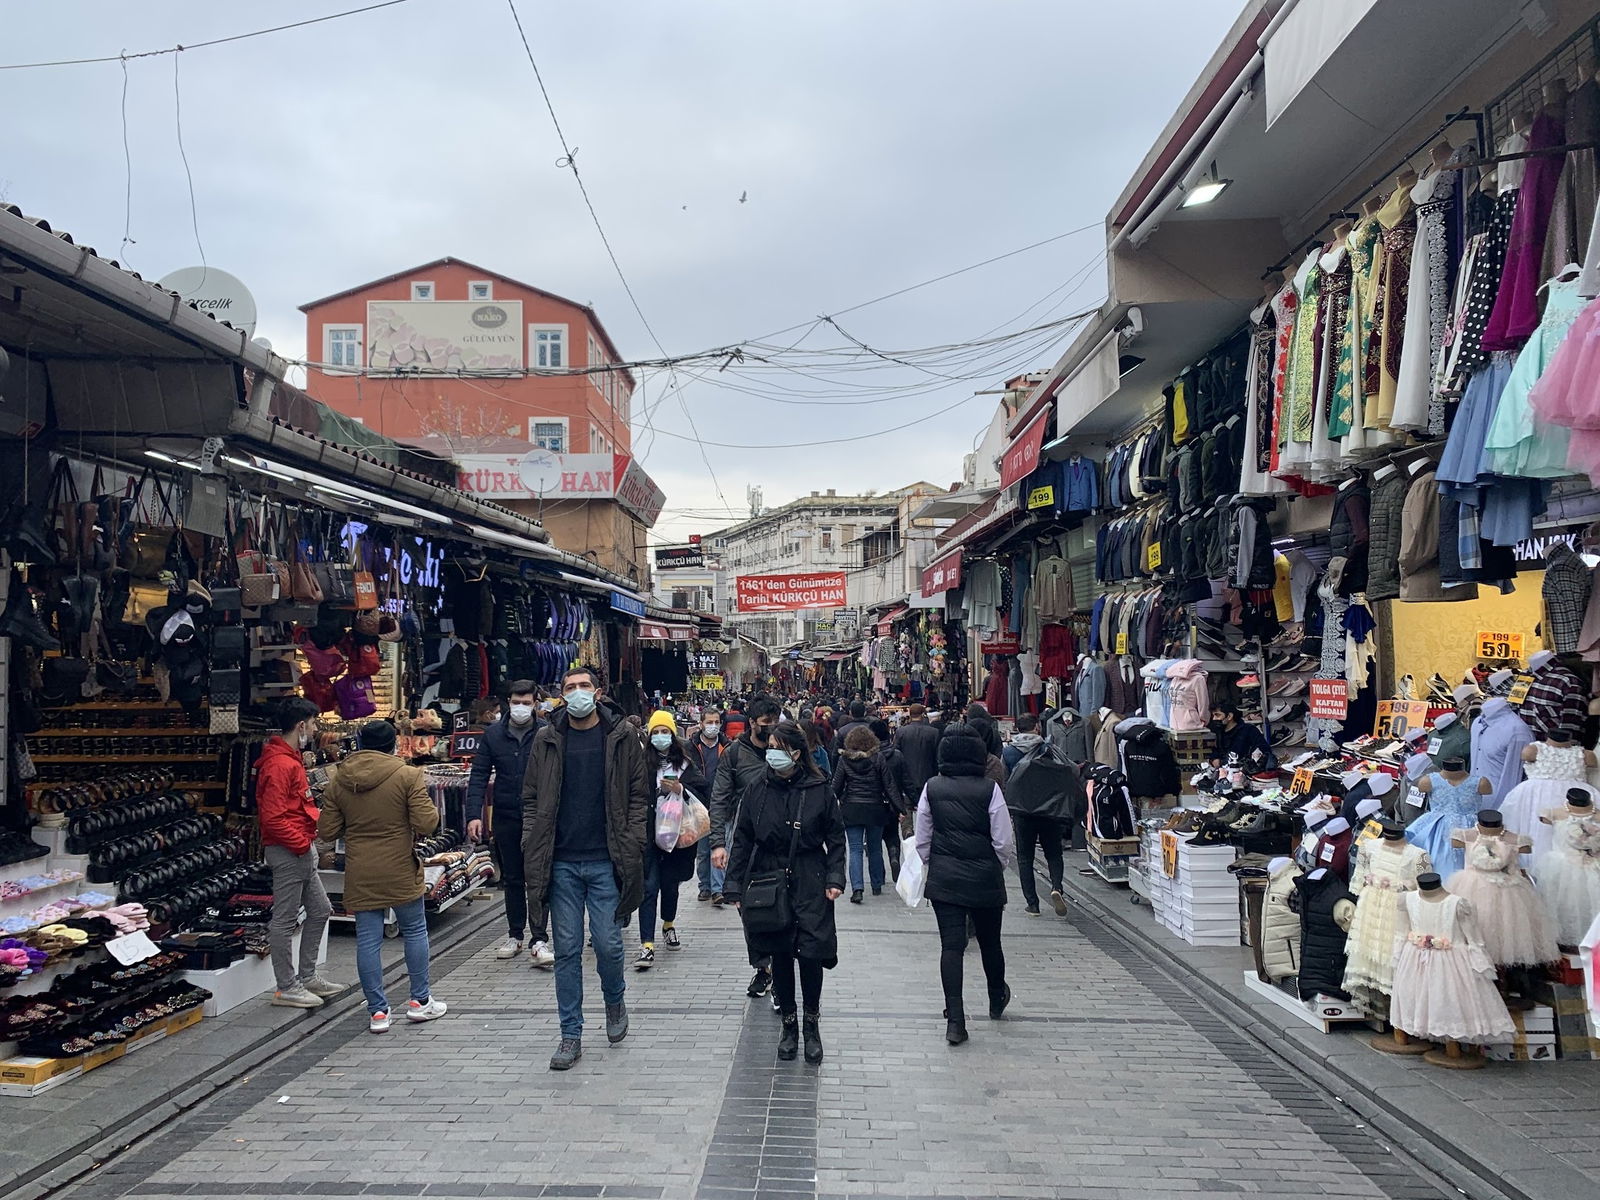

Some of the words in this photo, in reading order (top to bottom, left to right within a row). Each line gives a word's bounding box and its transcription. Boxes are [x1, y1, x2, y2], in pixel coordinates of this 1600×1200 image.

[463, 335, 496, 343] GÜLÜM
[498, 335, 515, 343] YÜN
[456, 469, 536, 498] KÜRK
[561, 471, 612, 492] HAN
[1032, 492, 1050, 503] 199
[1512, 537, 1545, 561] HAN
[656, 556, 685, 567] KÜRKÇÜ
[686, 556, 702, 565] HAN
[740, 580, 785, 591] 1461'den
[788, 577, 842, 589] Günümüze
[740, 592, 769, 605] Tarihi
[772, 590, 817, 605] KÜRKÇÜ
[820, 590, 844, 601] HAN
[1492, 632, 1509, 641] 199
[1482, 641, 1510, 658] 50
[1511, 650, 1521, 658] TL
[1312, 684, 1331, 695] TOLGA
[1331, 682, 1346, 698] ÇEYİZ
[1312, 705, 1346, 715] BİNDALLI
[1315, 699, 1344, 707] KAFTAN
[1390, 701, 1409, 713] 199
[1377, 715, 1408, 738] 50
[1292, 779, 1306, 794] 50
